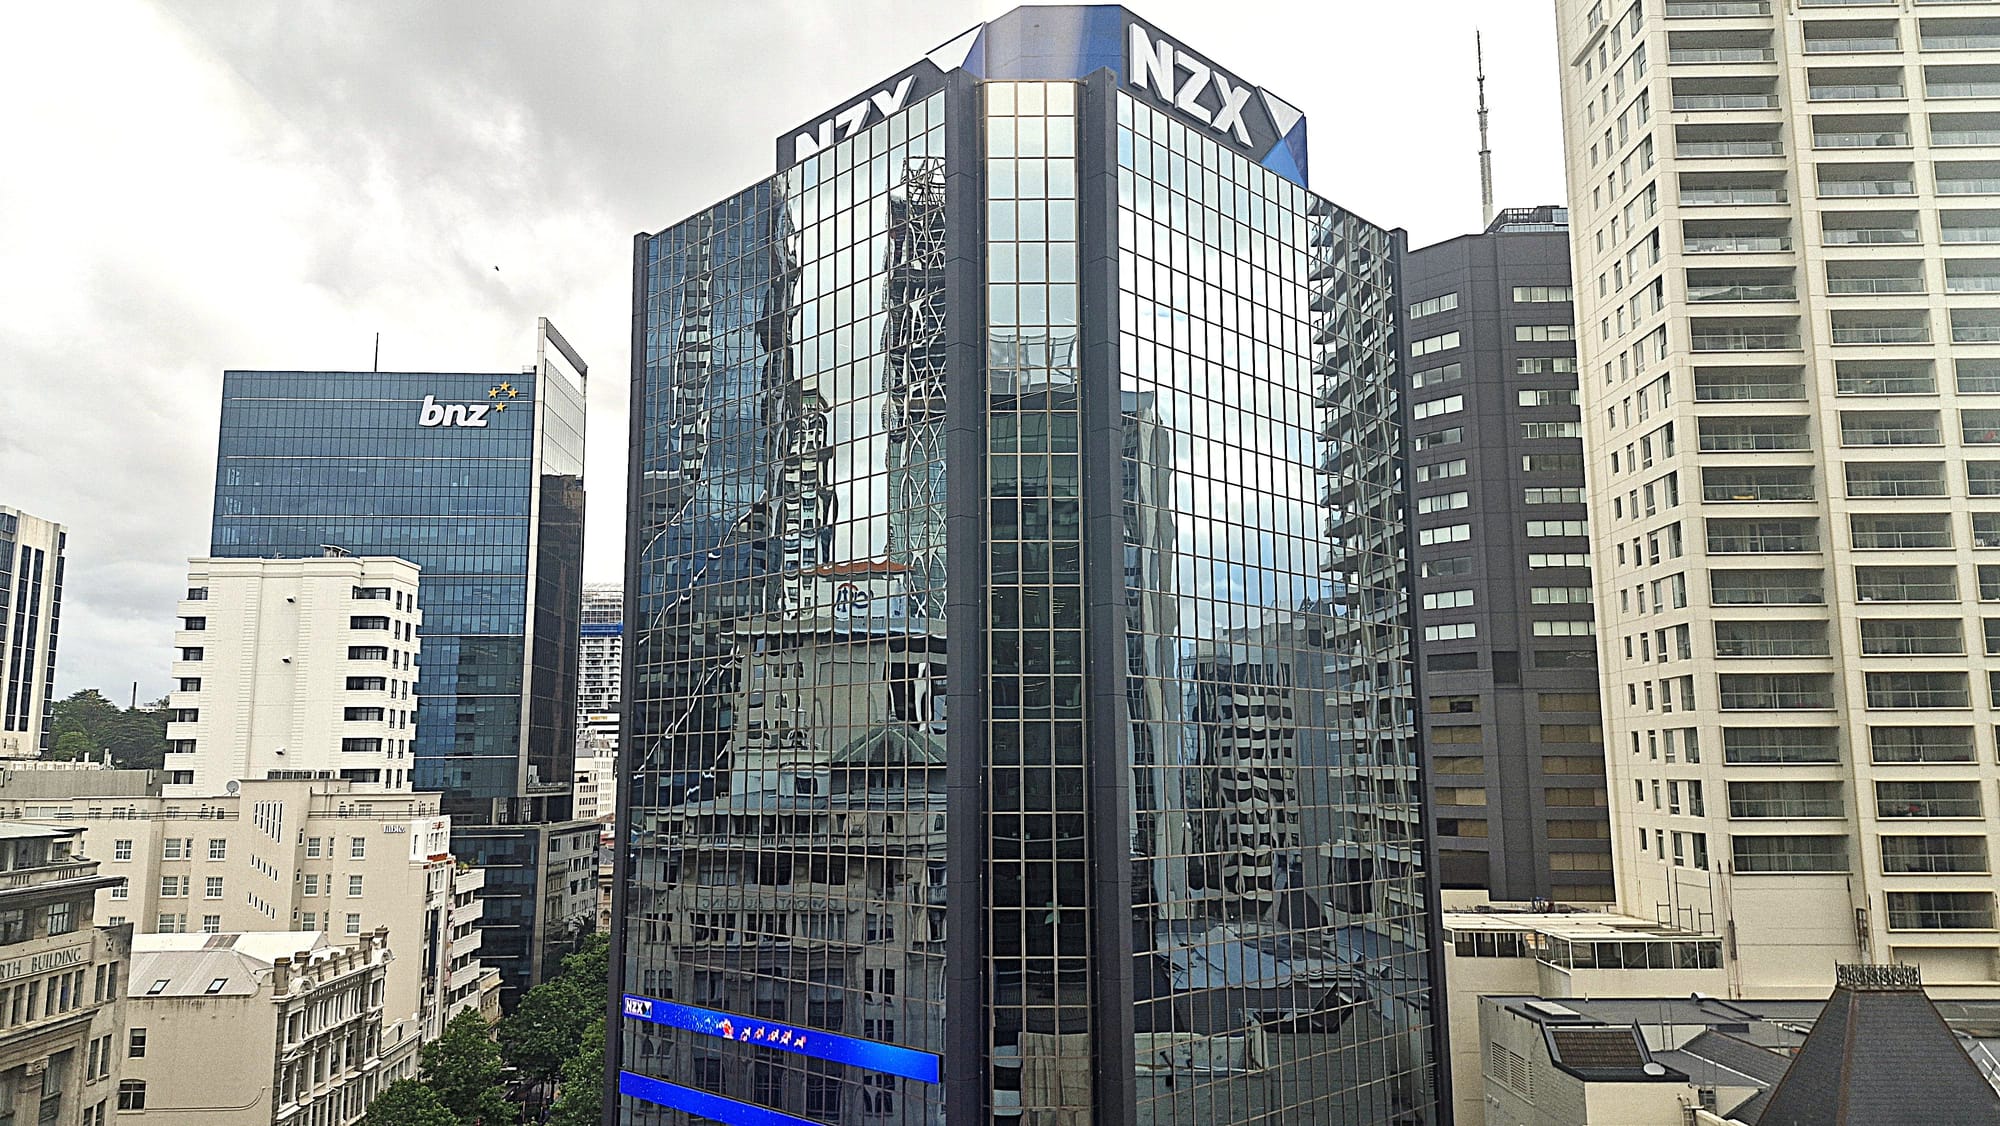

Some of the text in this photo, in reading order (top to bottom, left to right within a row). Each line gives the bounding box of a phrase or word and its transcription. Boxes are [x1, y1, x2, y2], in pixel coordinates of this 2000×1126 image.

[1129, 23, 1254, 148] NZX
[419, 395, 490, 427] bnz
[32, 948, 81, 971] BUILDING
[626, 999, 643, 1016] NZX
